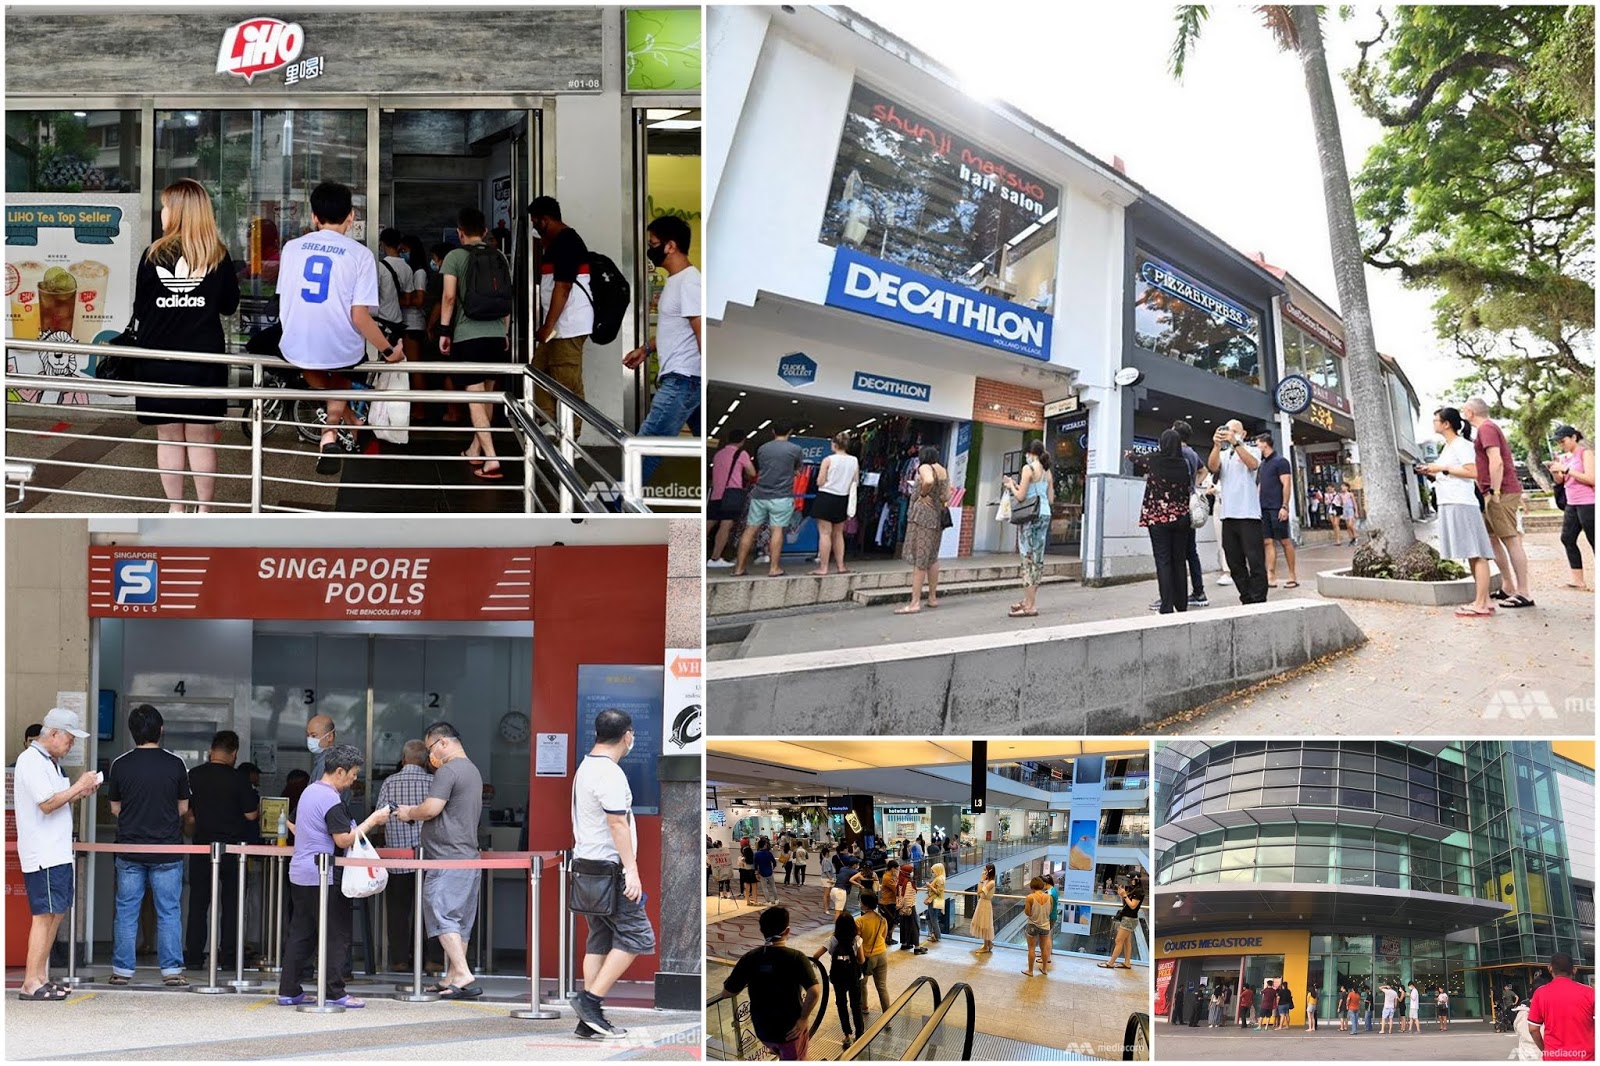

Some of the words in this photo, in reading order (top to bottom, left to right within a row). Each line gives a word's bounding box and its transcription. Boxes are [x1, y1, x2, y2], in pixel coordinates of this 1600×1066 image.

[216, 23, 304, 73] LiHO
[568, 79, 600, 88] #01-08
[960, 163, 996, 193] hair
[1000, 185, 1043, 216] salon
[8, 212, 34, 222] LiHO
[37, 212, 54, 222] Tea
[57, 212, 76, 224] Top
[79, 212, 111, 222] Seller
[301, 255, 333, 303] 9
[156, 294, 206, 308] adidas
[844, 263, 1043, 347] DECATHLON
[994, 338, 1019, 350] HOLLAND
[858, 376, 927, 398] DECATHLON
[802, 446, 824, 458] REE
[258, 557, 430, 580] SINGAPORE
[325, 582, 425, 605] POOLS
[113, 605, 158, 613] POOLS
[174, 681, 186, 697] 4
[304, 690, 315, 705] 3
[428, 693, 440, 708] 2
[974, 799, 983, 807] L3
[1163, 940, 1197, 954] COURTS
[1198, 937, 1263, 949] MEGASTORE
